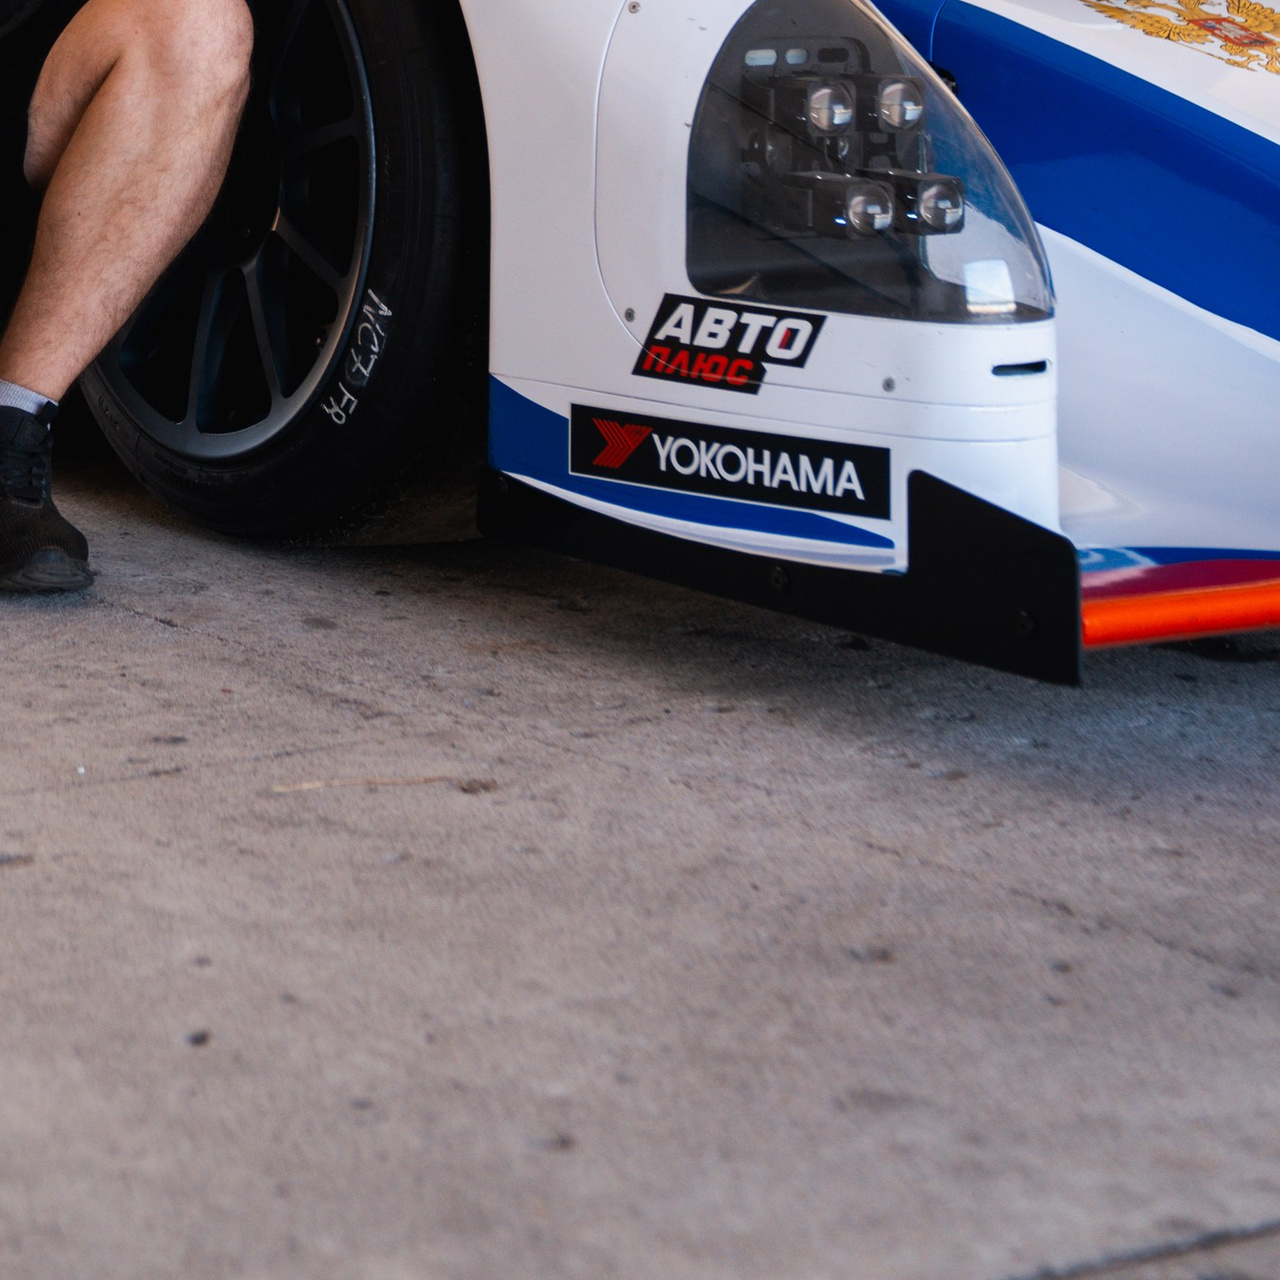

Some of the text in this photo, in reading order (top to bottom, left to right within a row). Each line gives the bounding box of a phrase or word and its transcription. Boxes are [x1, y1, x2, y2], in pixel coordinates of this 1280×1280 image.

[654, 303, 813, 360] АВТО
[642, 345, 755, 386] ПЛЮС
[321, 381, 358, 424] FR
[652, 432, 866, 501] YOKOHAMA
